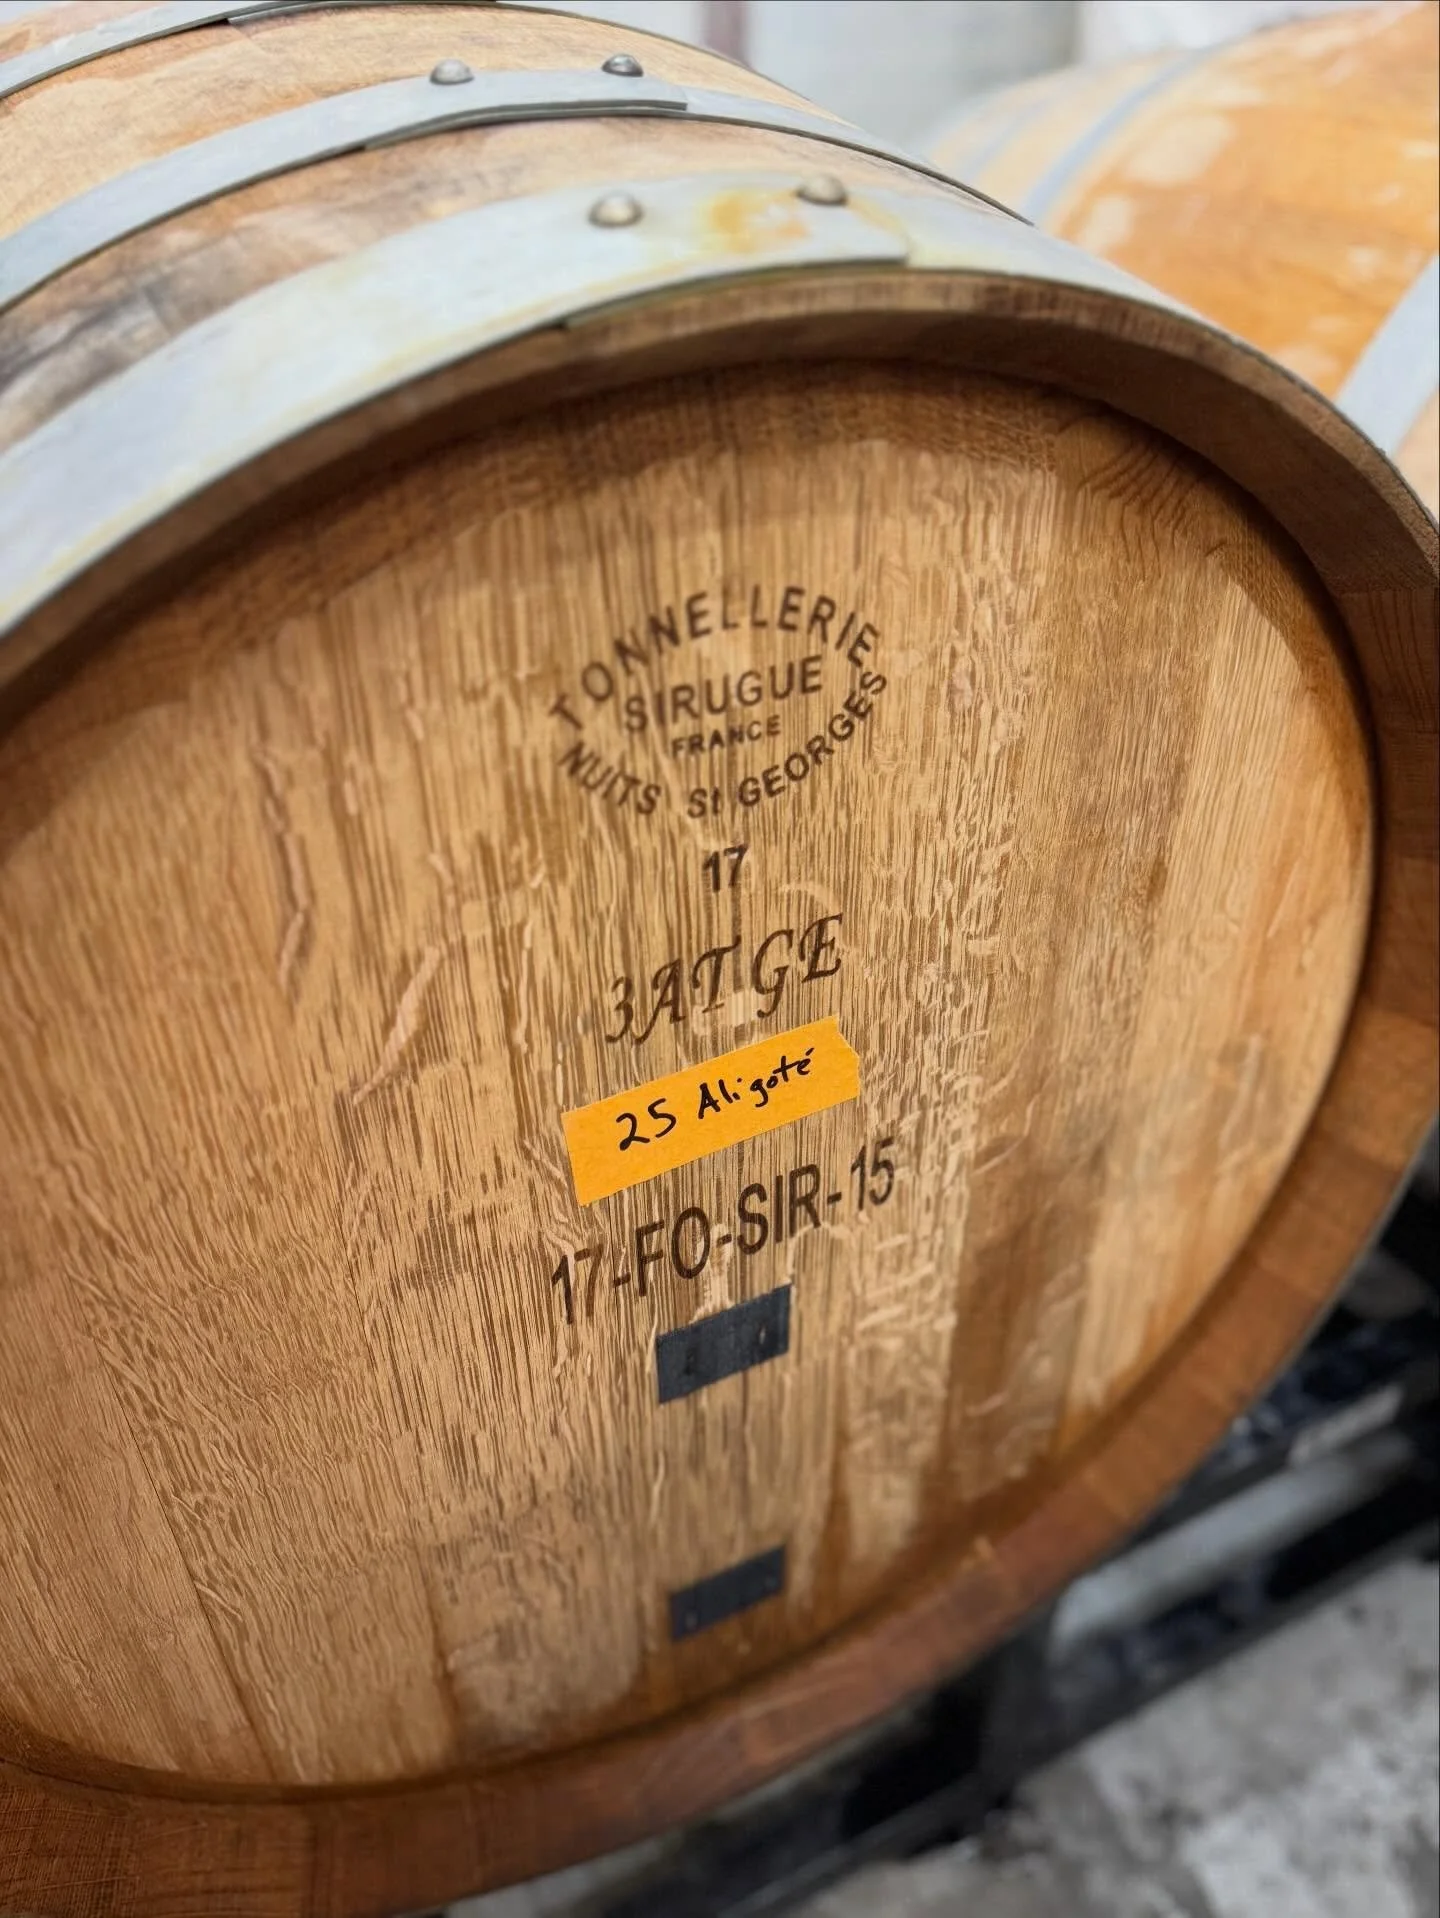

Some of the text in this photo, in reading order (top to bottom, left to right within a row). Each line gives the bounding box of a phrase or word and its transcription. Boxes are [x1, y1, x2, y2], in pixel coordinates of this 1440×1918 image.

[550, 585, 879, 731] TONNELLERIE
[624, 654, 823, 733] SIRUGUE
[558, 740, 661, 815] NUITS
[738, 670, 887, 807] GEORGES
[671, 714, 781, 758] FRANCE
[702, 844, 748, 893] 17
[615, 1047, 816, 1152] 25 Aligoté
[550, 1137, 896, 1326] 17-FO-SIR-15
